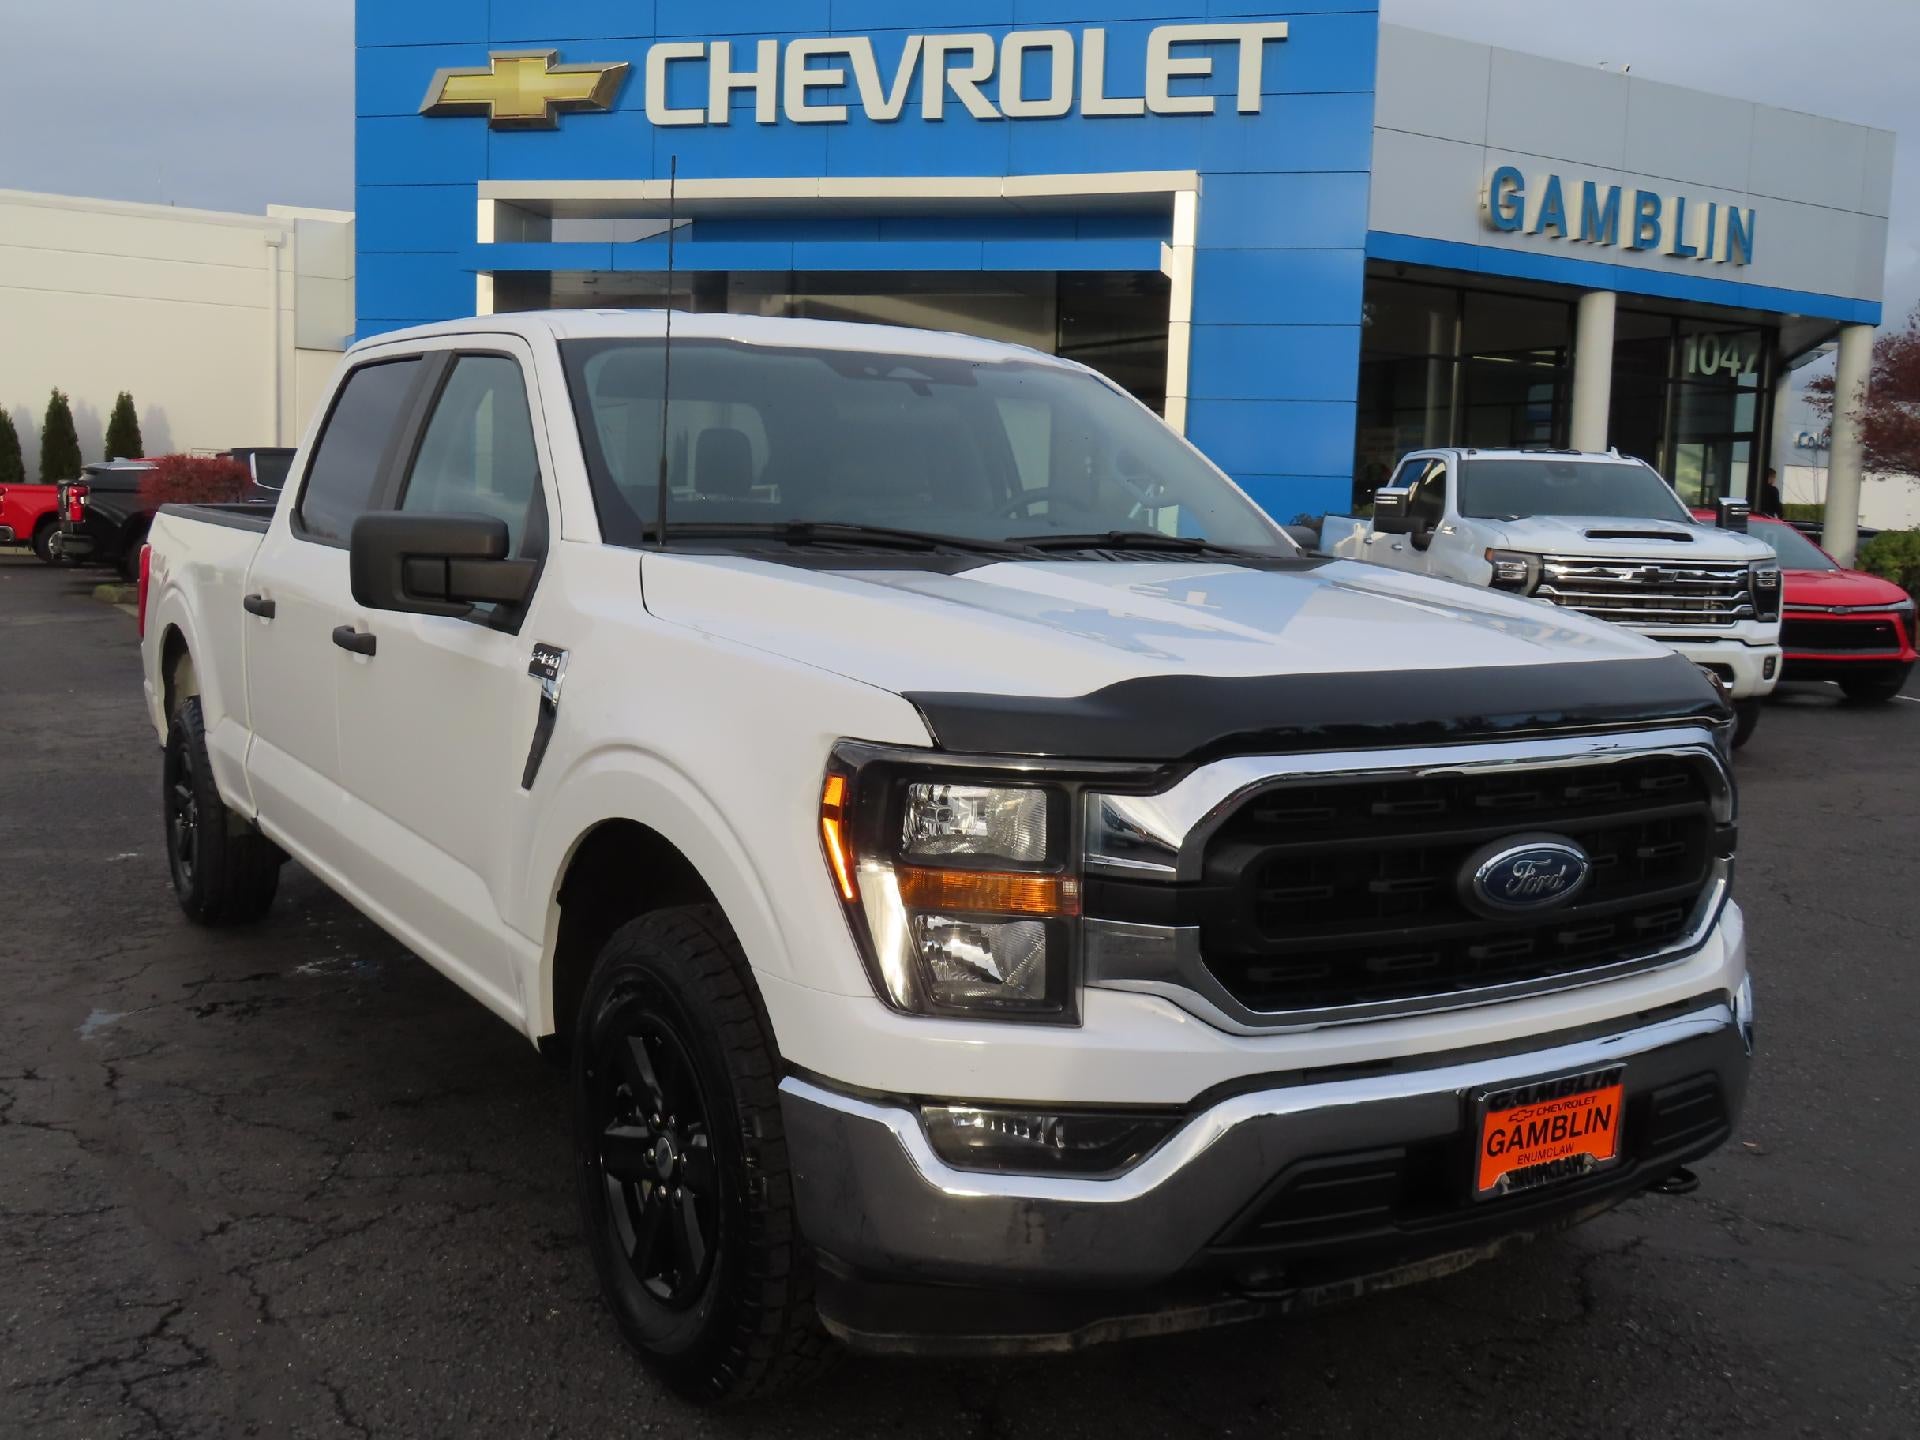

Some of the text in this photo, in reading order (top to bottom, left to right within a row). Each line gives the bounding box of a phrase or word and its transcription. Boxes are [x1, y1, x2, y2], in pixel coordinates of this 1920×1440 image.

[645, 20, 1290, 127] CHEVROLET
[1487, 165, 1757, 266] GAMBLIN
[1505, 859, 1567, 896] Ford
[1536, 1095, 1597, 1117] CHEVROLET
[1486, 1104, 1612, 1158] GAMBLIN
[1516, 1142, 1576, 1166] ENUMCLAW
